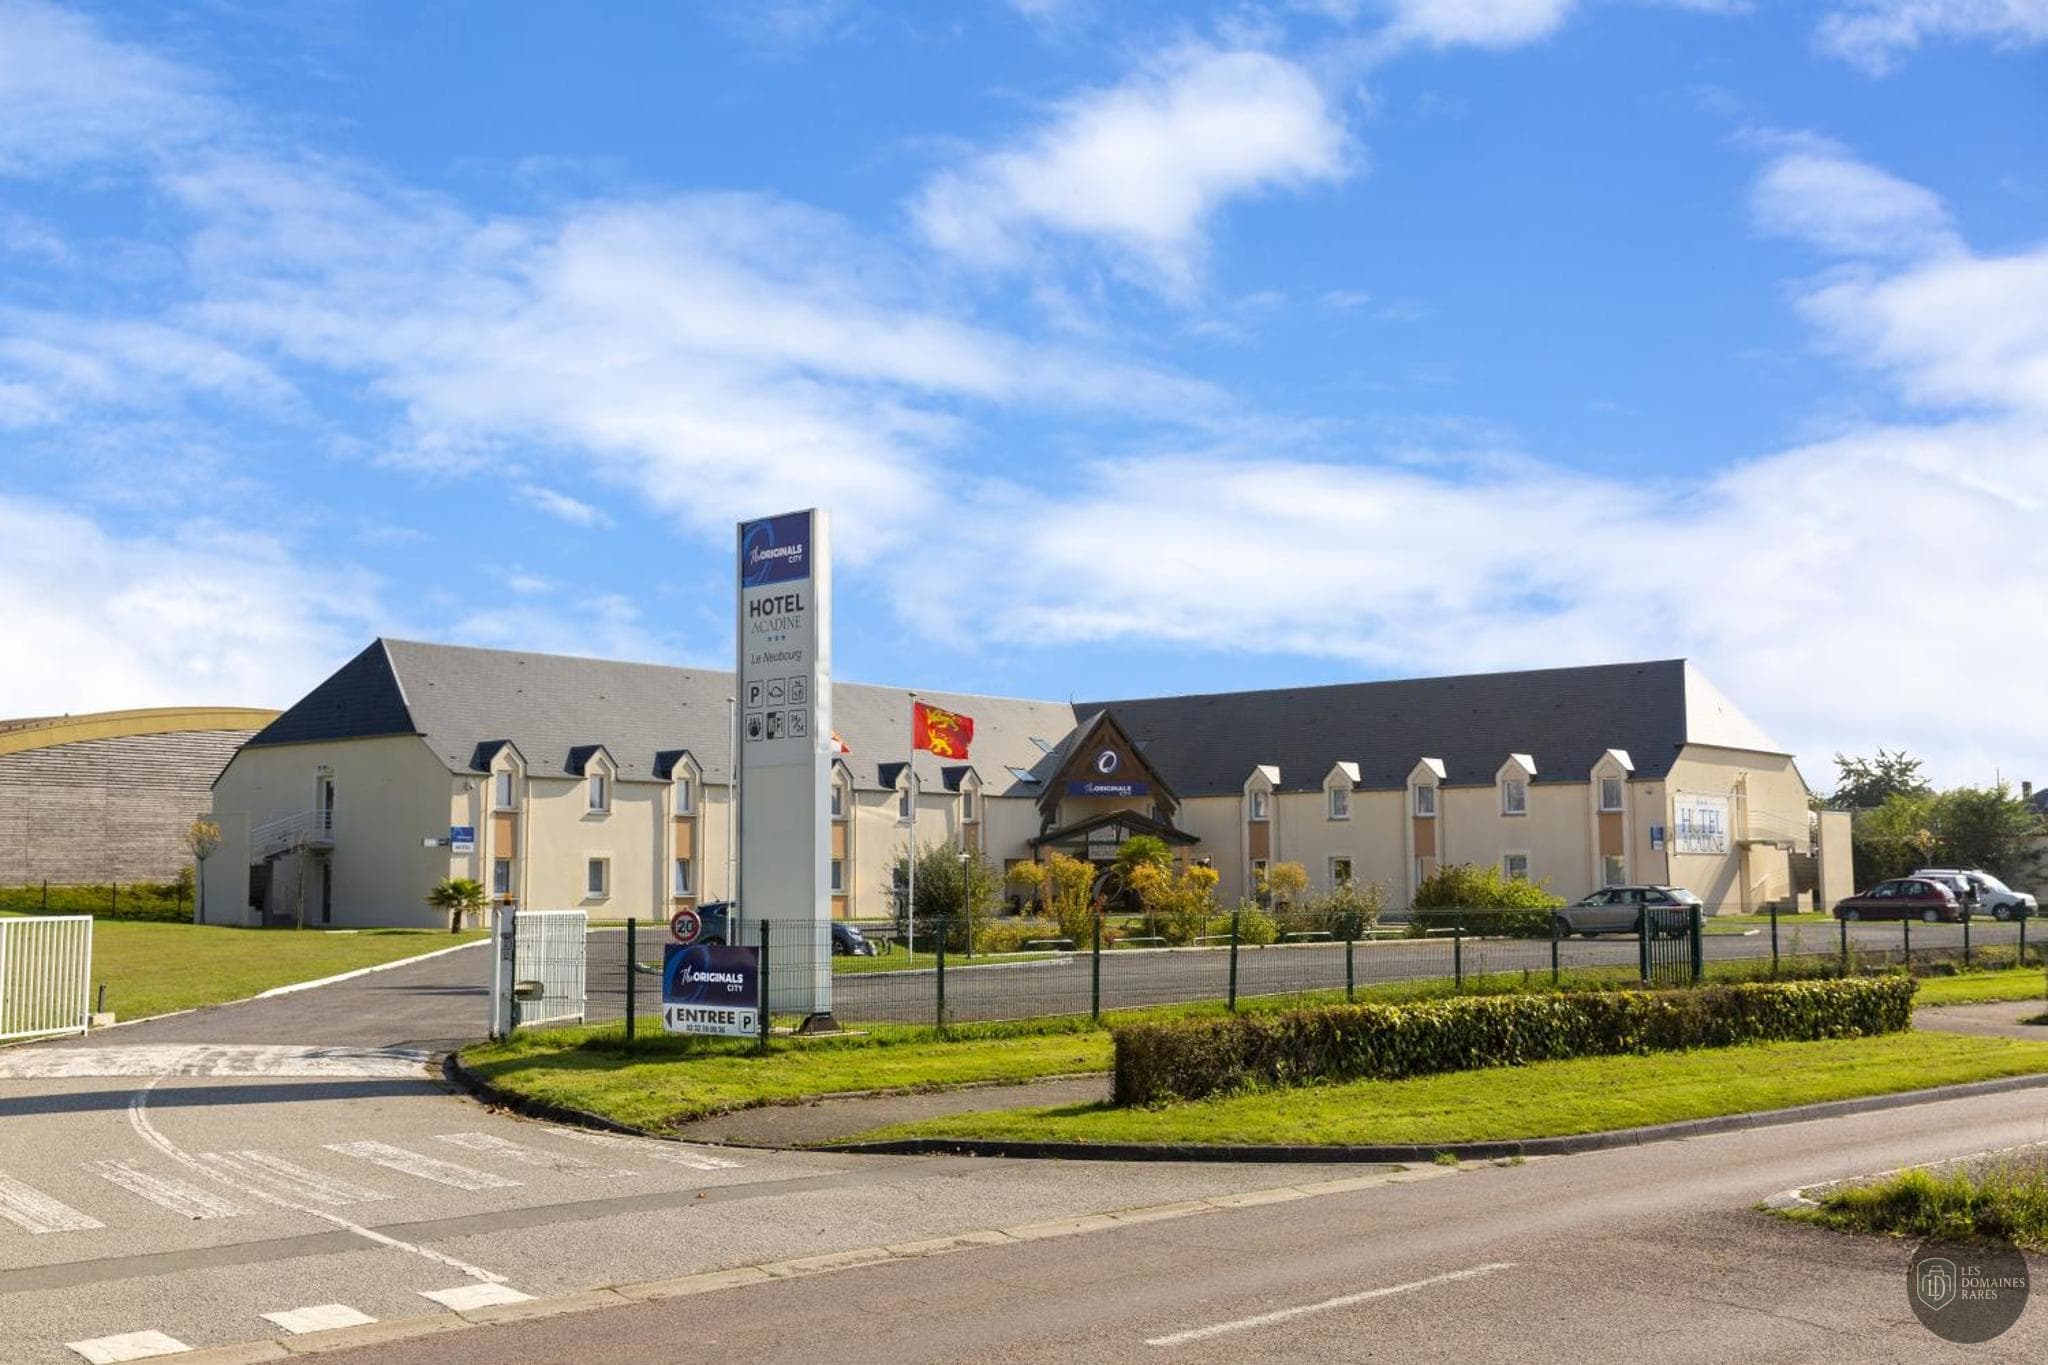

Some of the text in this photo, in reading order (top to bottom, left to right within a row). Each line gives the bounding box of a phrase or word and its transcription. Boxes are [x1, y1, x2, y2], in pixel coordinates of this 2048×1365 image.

[760, 544, 802, 560] ORIGINALS
[788, 554, 802, 564] CITY
[750, 593, 804, 618] HOTEL
[751, 615, 801, 634] ACADINE
[751, 653, 761, 665] Le
[677, 920, 694, 933] 20
[680, 964, 743, 985] The ORIGINALS
[727, 984, 743, 992] CITY
[677, 1008, 735, 1024] ENTREE
